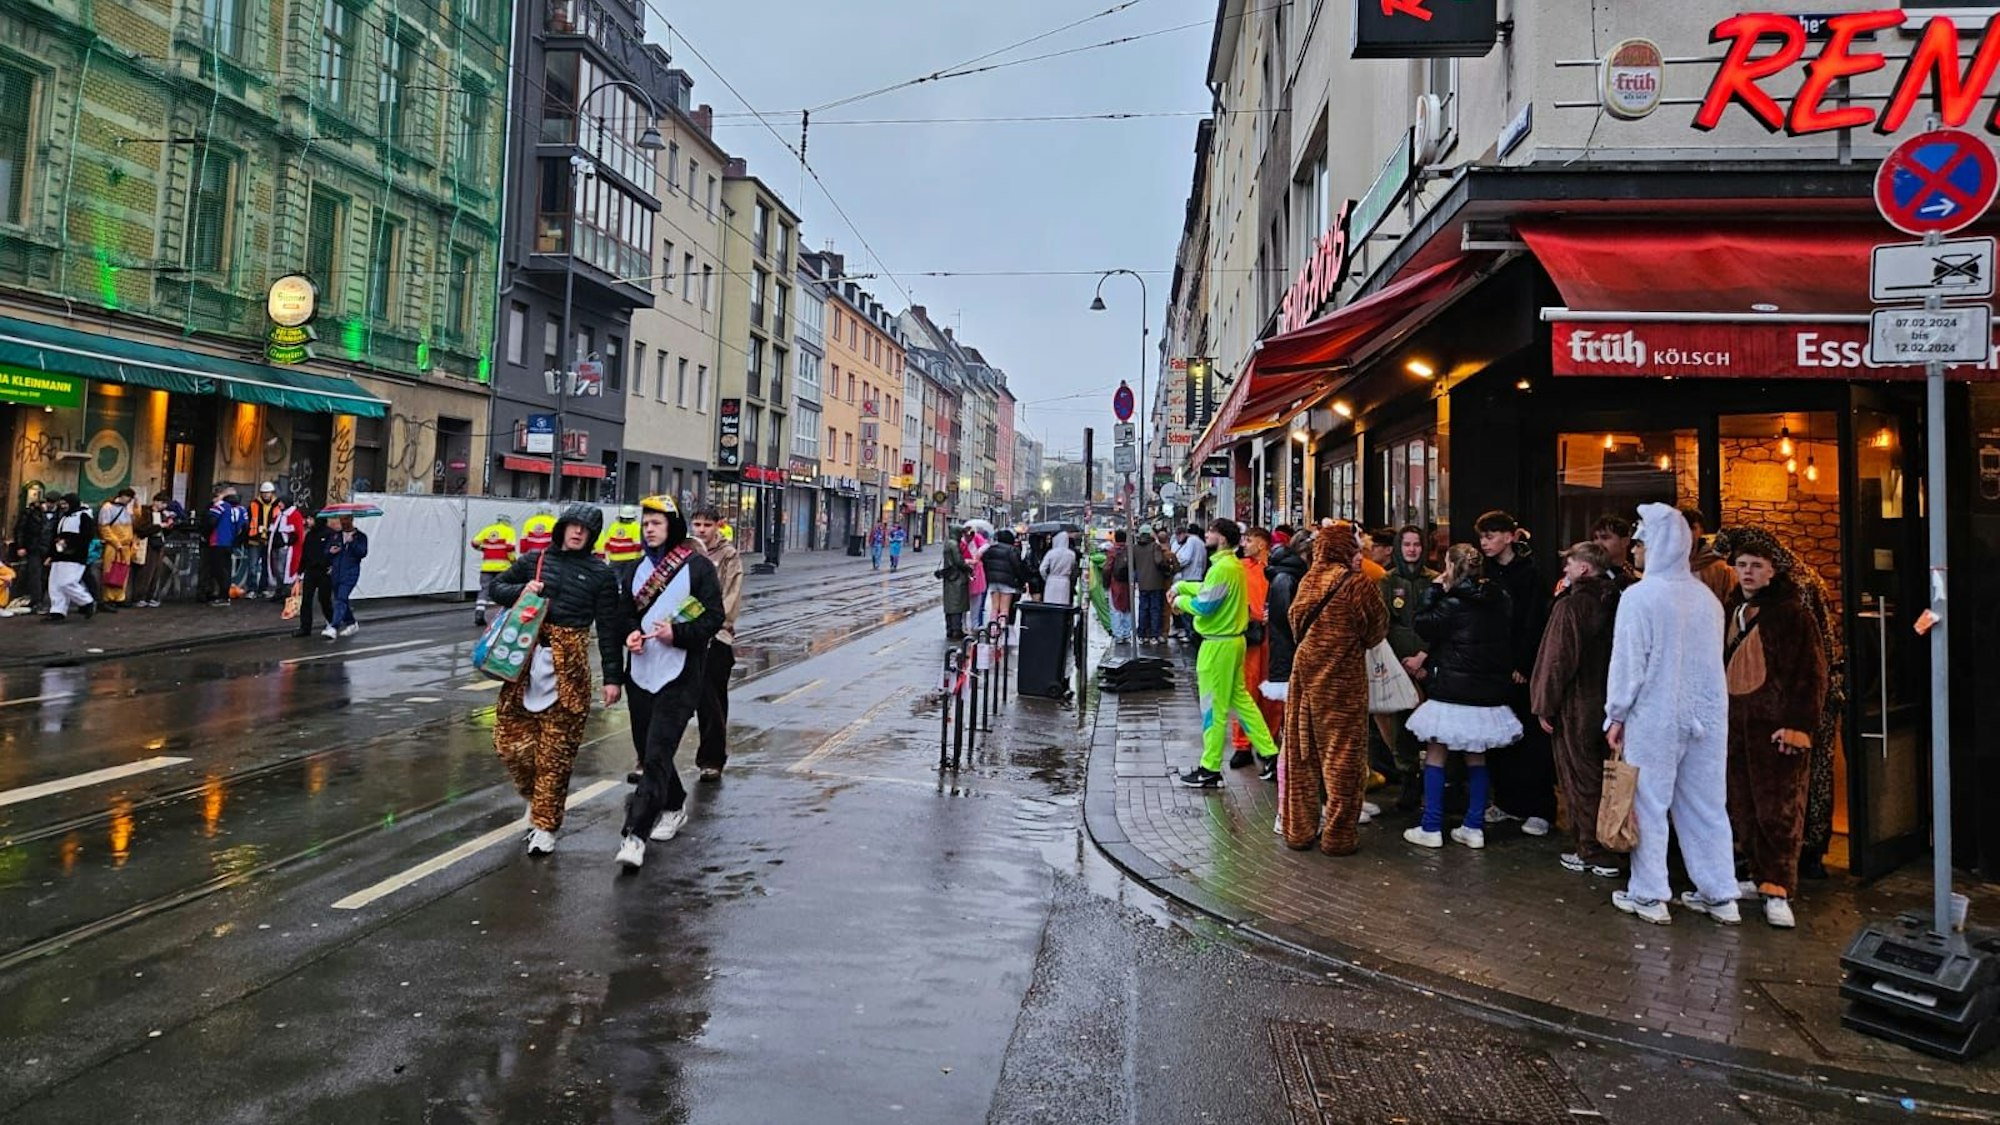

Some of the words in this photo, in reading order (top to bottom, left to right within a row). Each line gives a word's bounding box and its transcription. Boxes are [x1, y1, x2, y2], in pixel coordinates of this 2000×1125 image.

[1690, 8, 2000, 136] REN
[1616, 72, 1656, 92] früh
[1896, 318, 1957, 327] 07.02.2024
[1911, 331, 1929, 340] bis
[1567, 329, 1647, 368] früh
[1654, 347, 1730, 366] KÖLSCH
[1895, 343, 1956, 353] 12.02.2024
[12, 374, 72, 393] KLEINMANN
